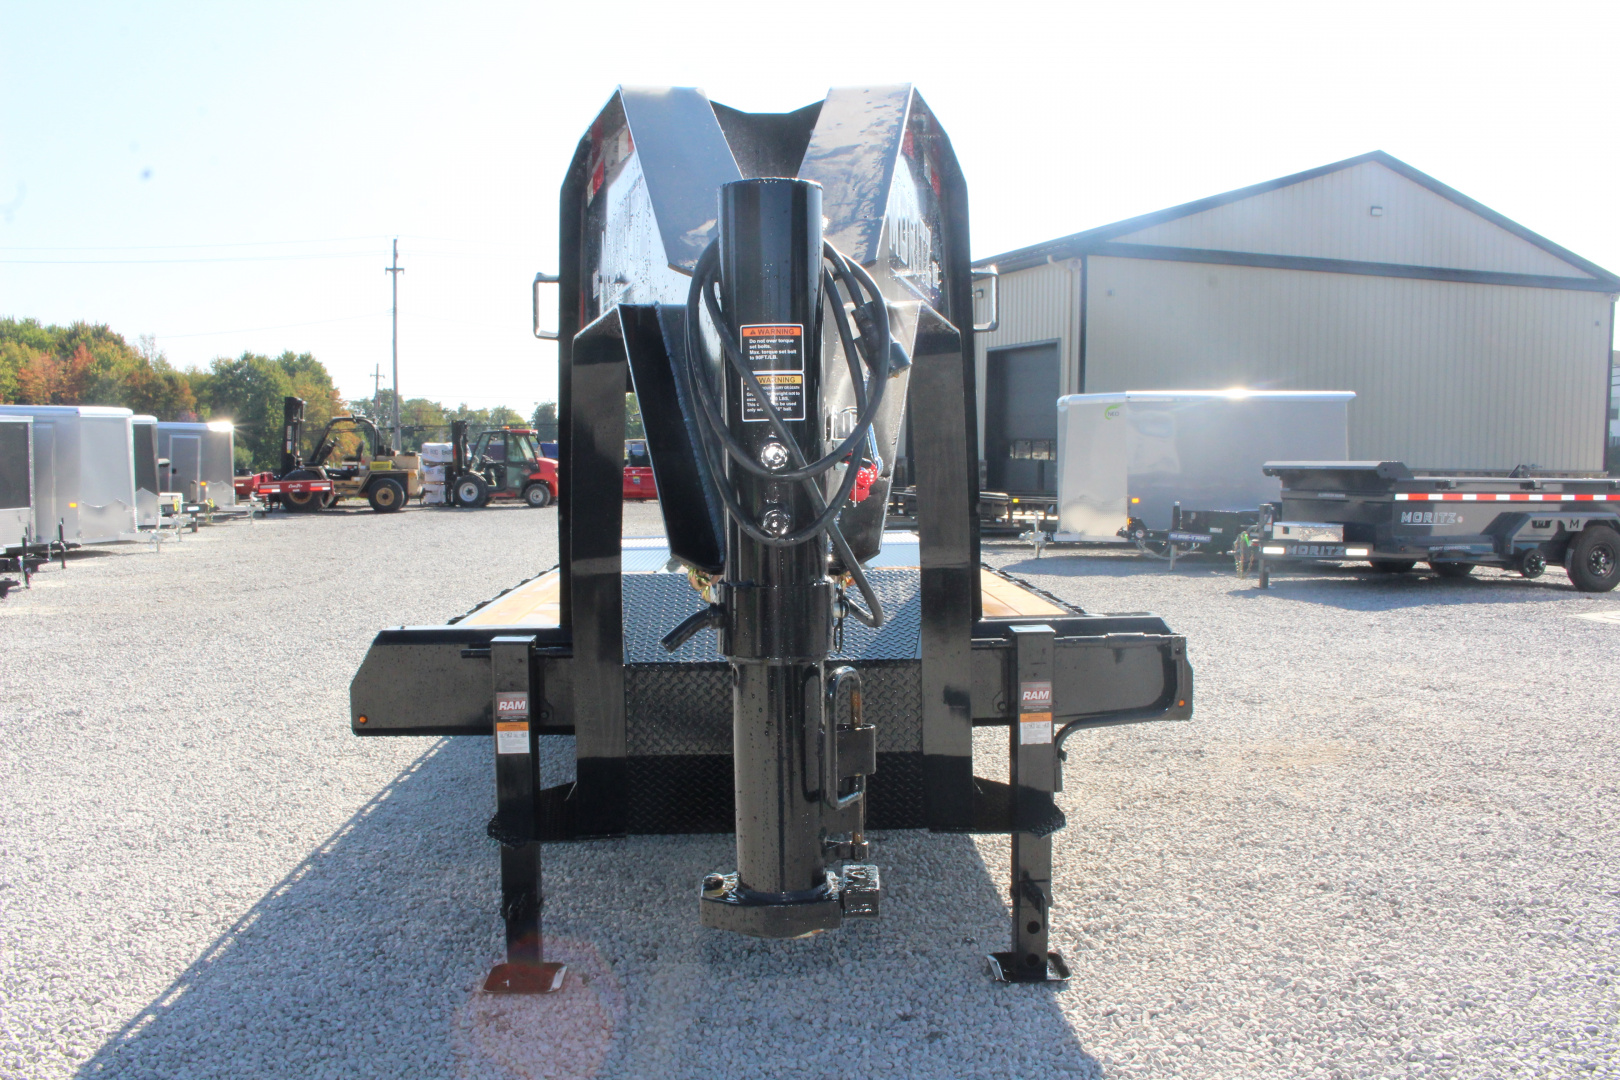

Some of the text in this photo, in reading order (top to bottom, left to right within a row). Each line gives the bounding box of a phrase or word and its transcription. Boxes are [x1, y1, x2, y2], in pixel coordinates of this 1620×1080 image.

[1401, 511, 1457, 523] MORITZ
[1569, 519, 1580, 528] M
[1286, 544, 1345, 556] MORITZ
[1022, 690, 1050, 701] RAM
[498, 700, 526, 711] RAM
